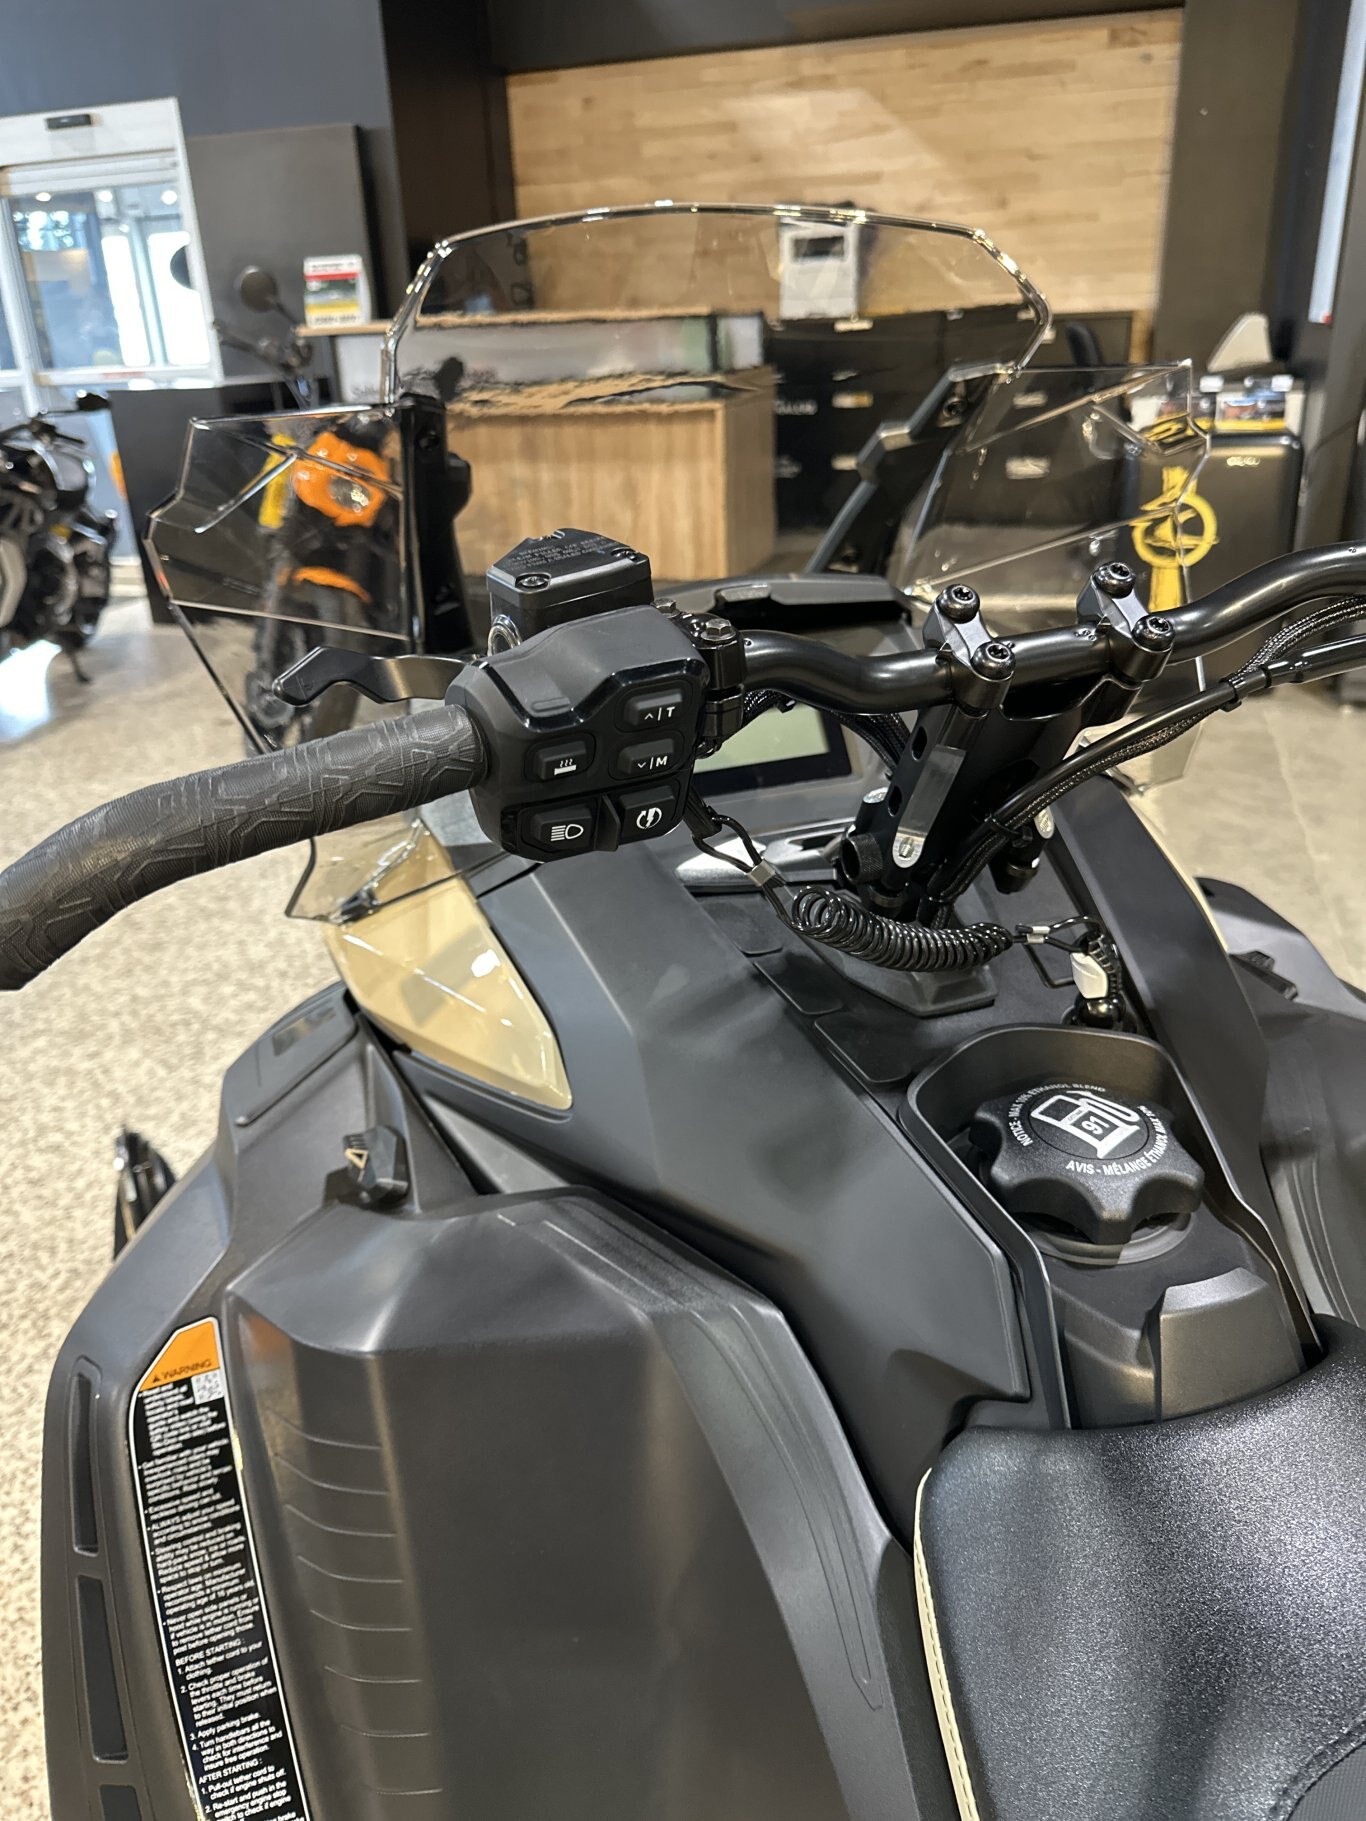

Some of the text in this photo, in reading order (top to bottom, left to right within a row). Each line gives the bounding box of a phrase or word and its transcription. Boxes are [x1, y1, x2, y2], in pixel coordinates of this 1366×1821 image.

[1028, 1083, 1071, 1095] ETHANOL
[1072, 1083, 1106, 1092] BLEND
[1008, 1103, 1023, 1117] MAX
[1009, 1120, 1033, 1146] NOTICE
[1081, 1116, 1110, 1135] 91
[1066, 1160, 1095, 1174] AVIS
[1102, 1157, 1152, 1175] MÉLANGE
[1144, 1133, 1168, 1163] ÉTHANOL
[162, 1359, 212, 1379] WARNING
[175, 1638, 241, 1666] BEFORE STARTING
[199, 1758, 259, 1784] AFTER STARTING
